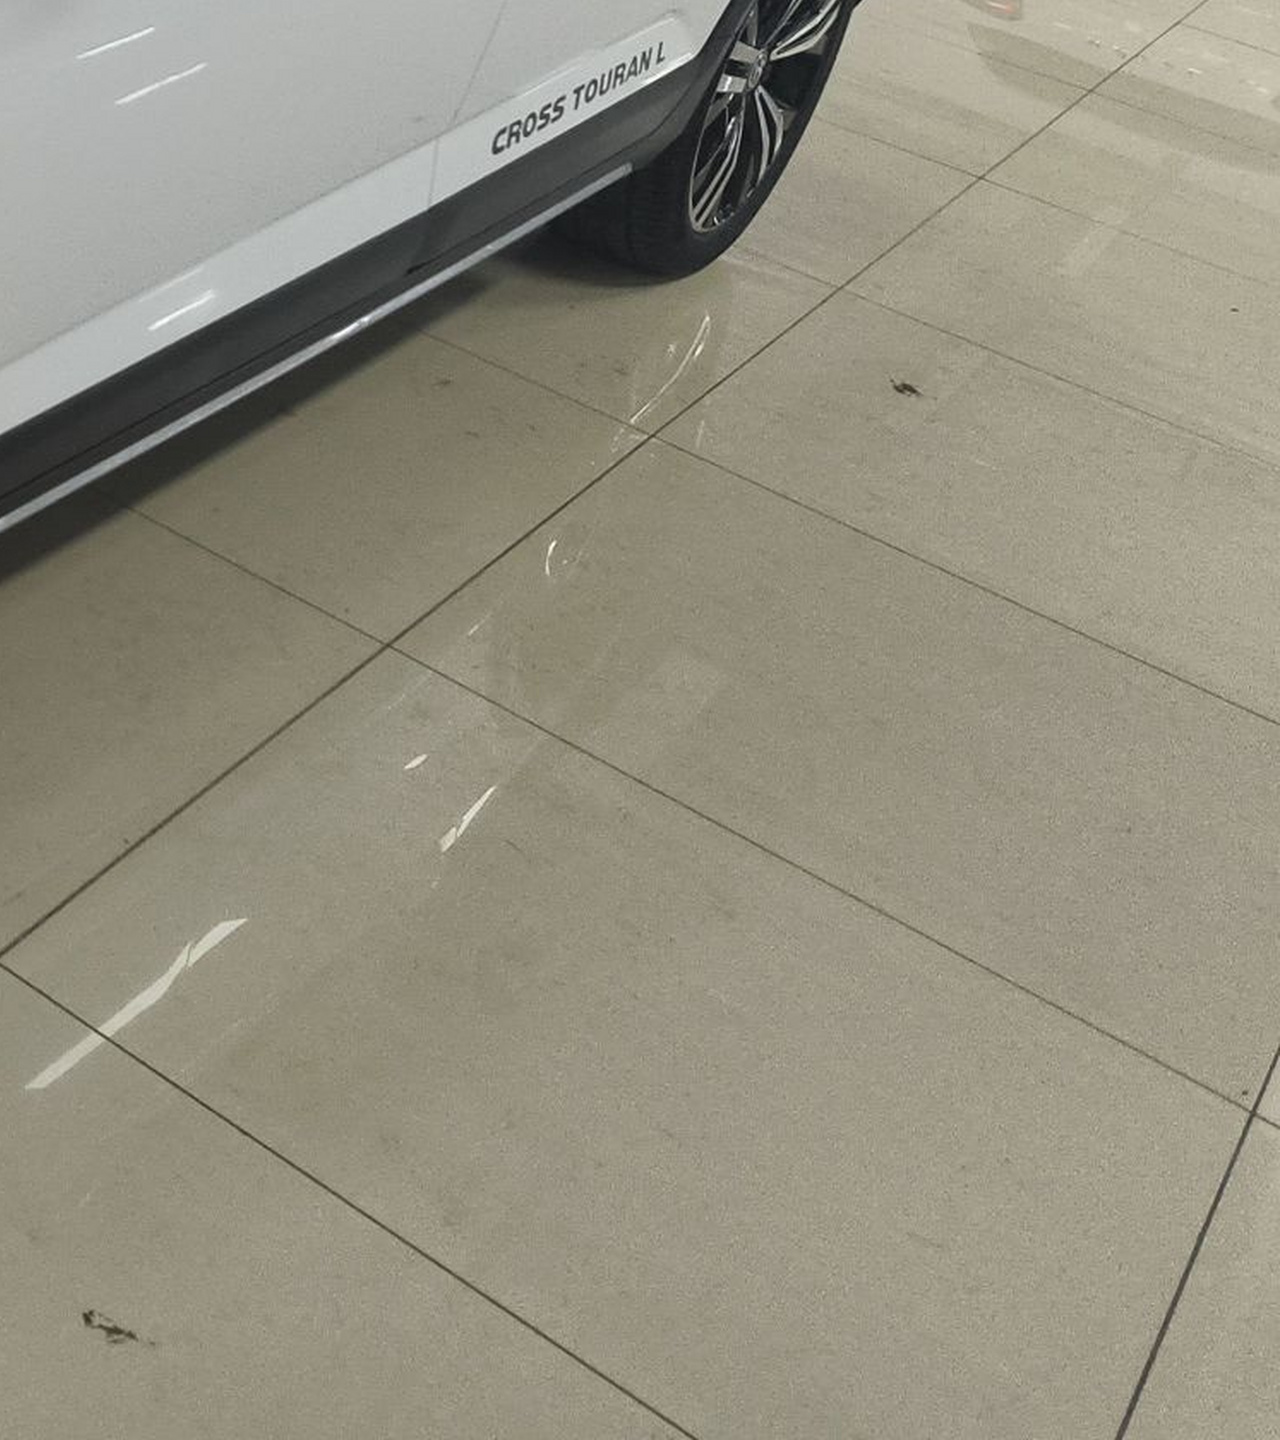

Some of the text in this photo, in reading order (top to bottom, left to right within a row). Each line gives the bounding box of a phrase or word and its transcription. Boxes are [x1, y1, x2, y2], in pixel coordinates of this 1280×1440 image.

[491, 41, 666, 155] CROSS TOURAN L
